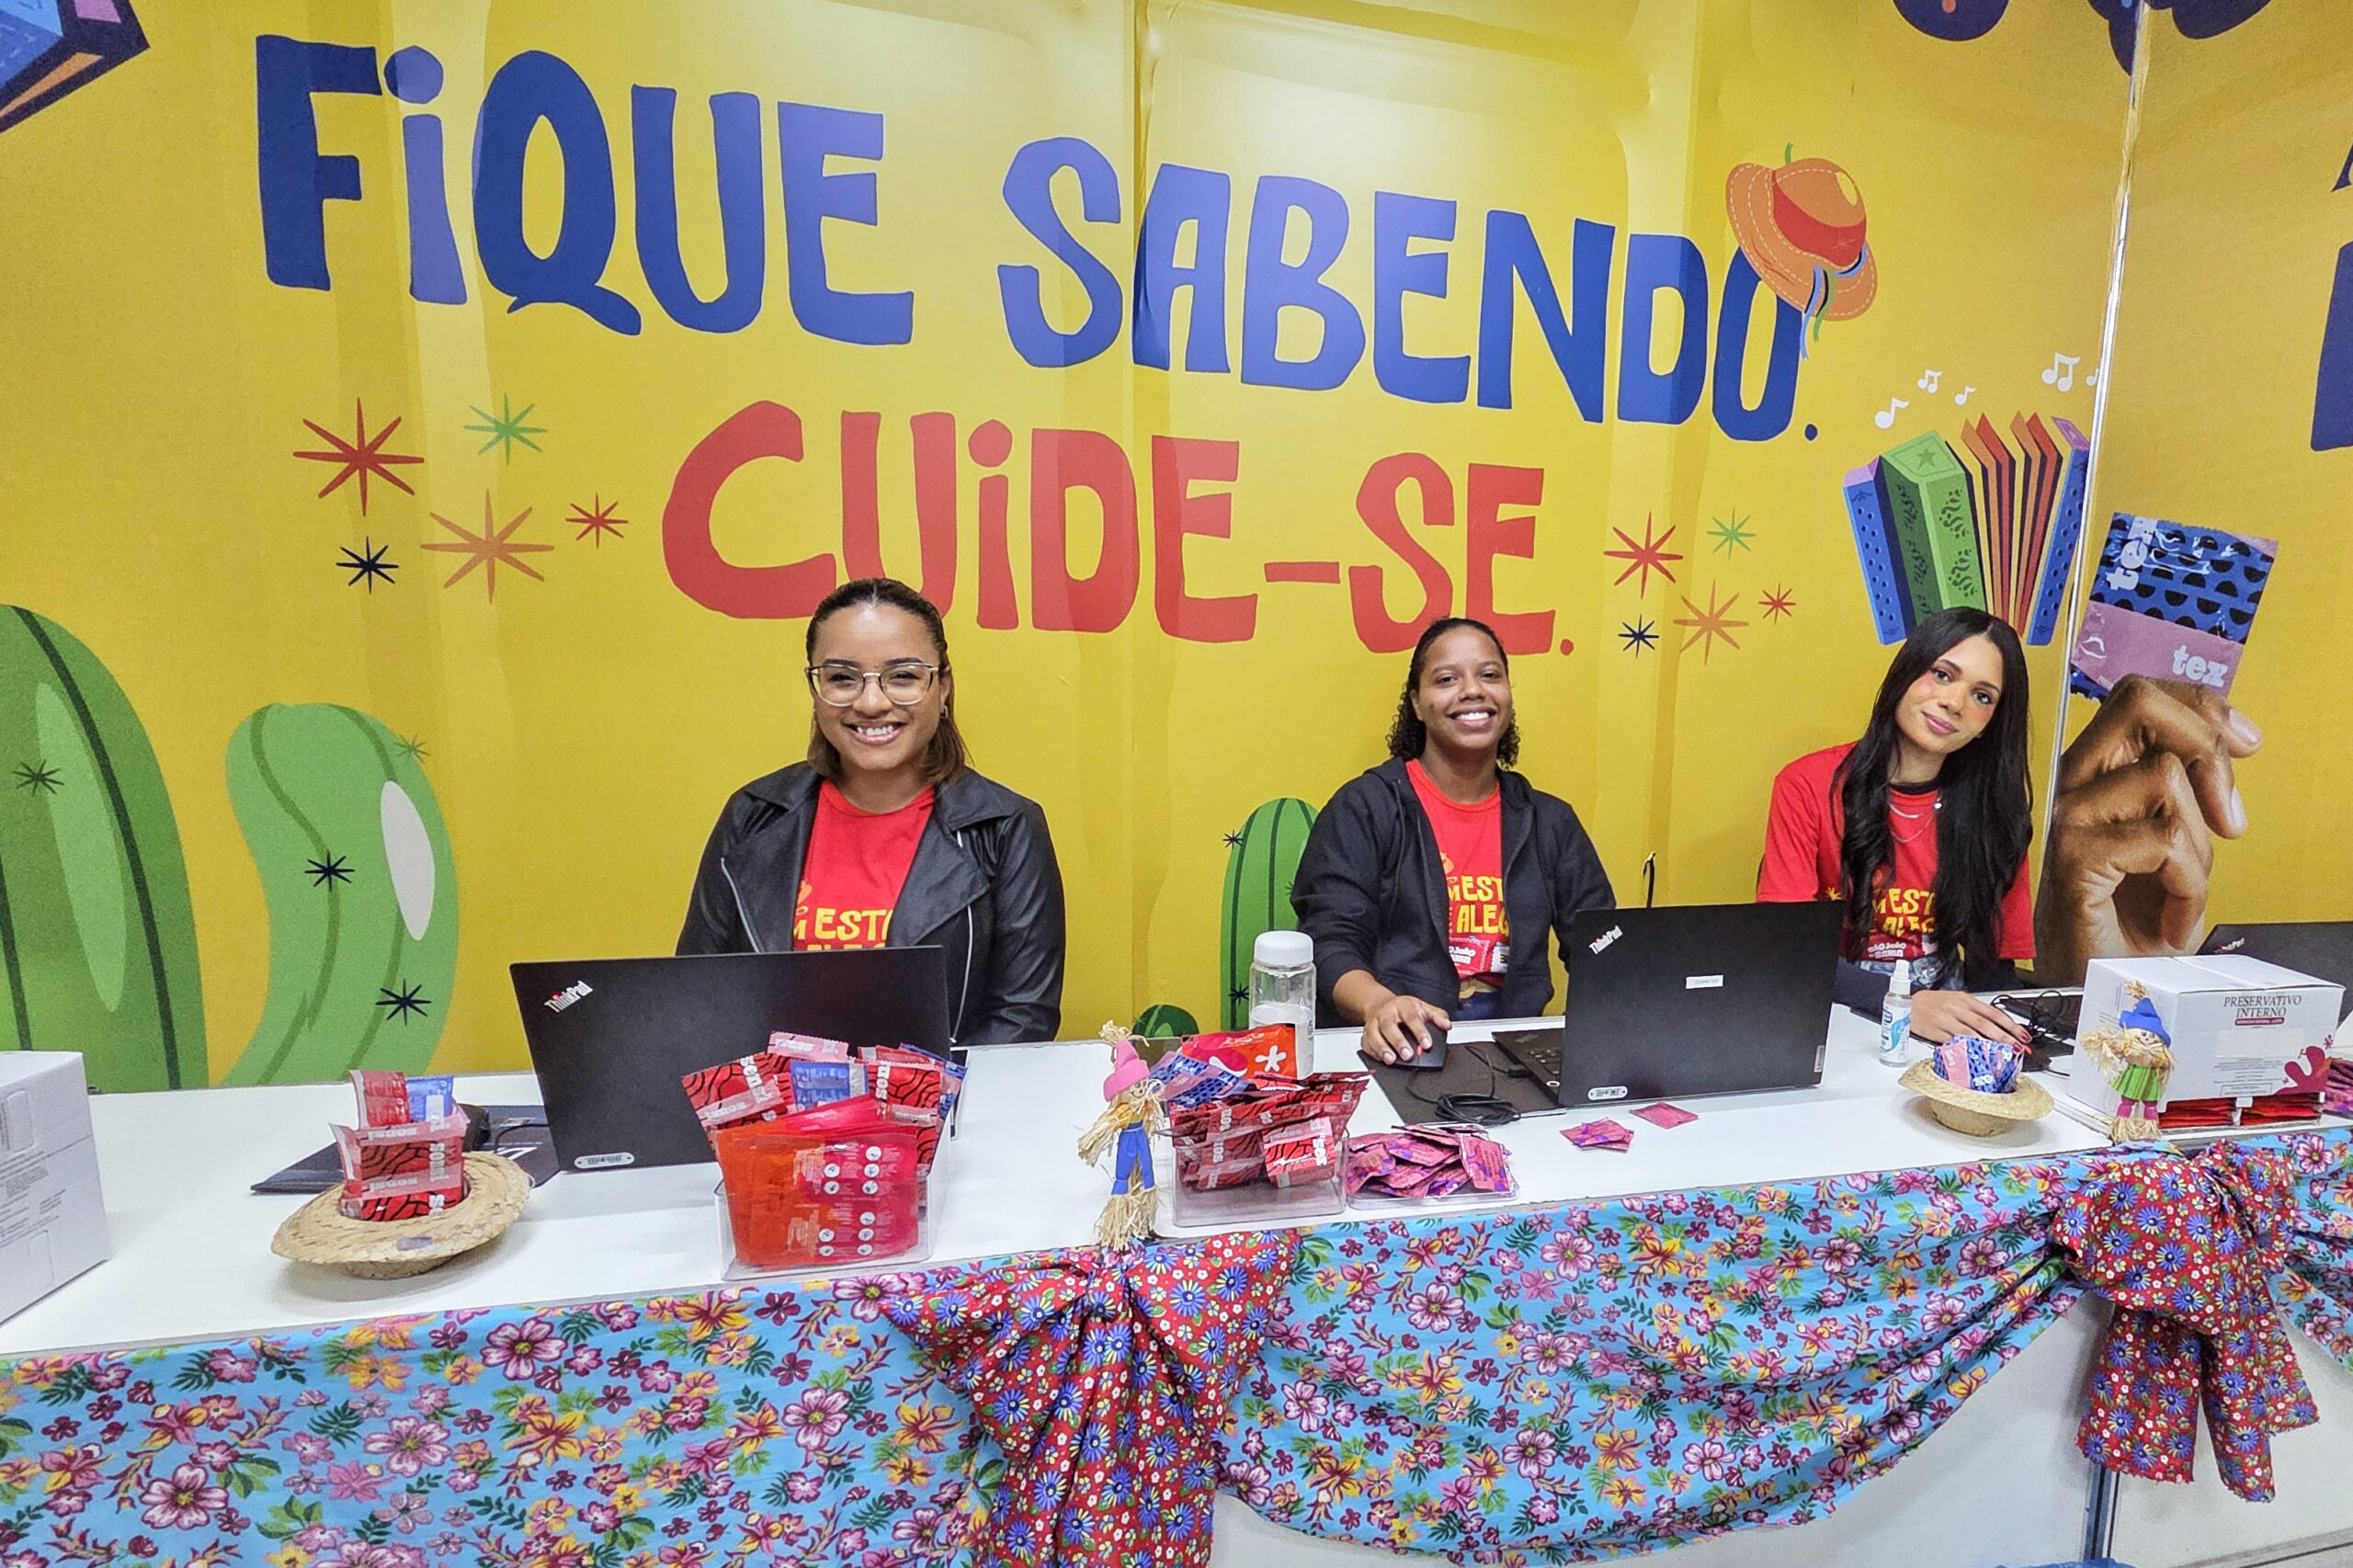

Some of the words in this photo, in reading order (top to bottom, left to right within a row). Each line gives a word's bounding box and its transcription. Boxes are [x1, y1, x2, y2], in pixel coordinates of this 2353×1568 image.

[2172, 645, 2228, 687] tex
[1588, 925, 1623, 955] ThinkPad
[544, 980, 594, 1013] ThinkPad
[2223, 994, 2302, 1008] PRESERVATIVO
[2235, 1006, 2287, 1018] INTERNO
